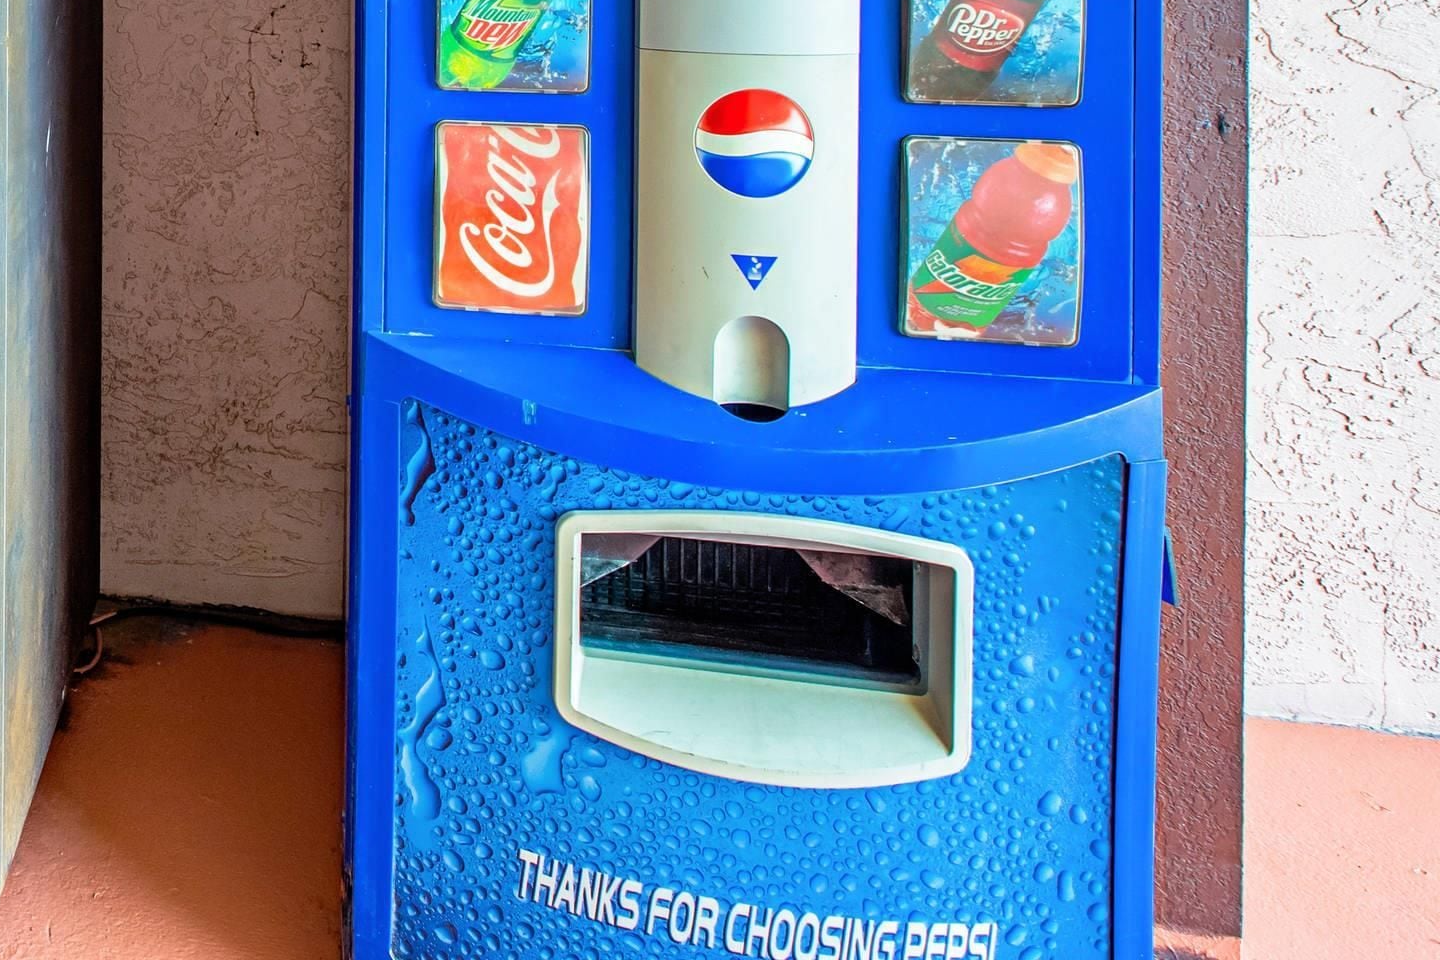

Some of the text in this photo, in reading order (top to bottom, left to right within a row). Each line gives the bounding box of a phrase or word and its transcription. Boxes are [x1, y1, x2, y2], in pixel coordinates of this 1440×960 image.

[948, 3, 1020, 46] Pepper
[973, 9, 1007, 30] Dr
[516, 848, 998, 960] THANKS FOR CHOOSING PEPSI
